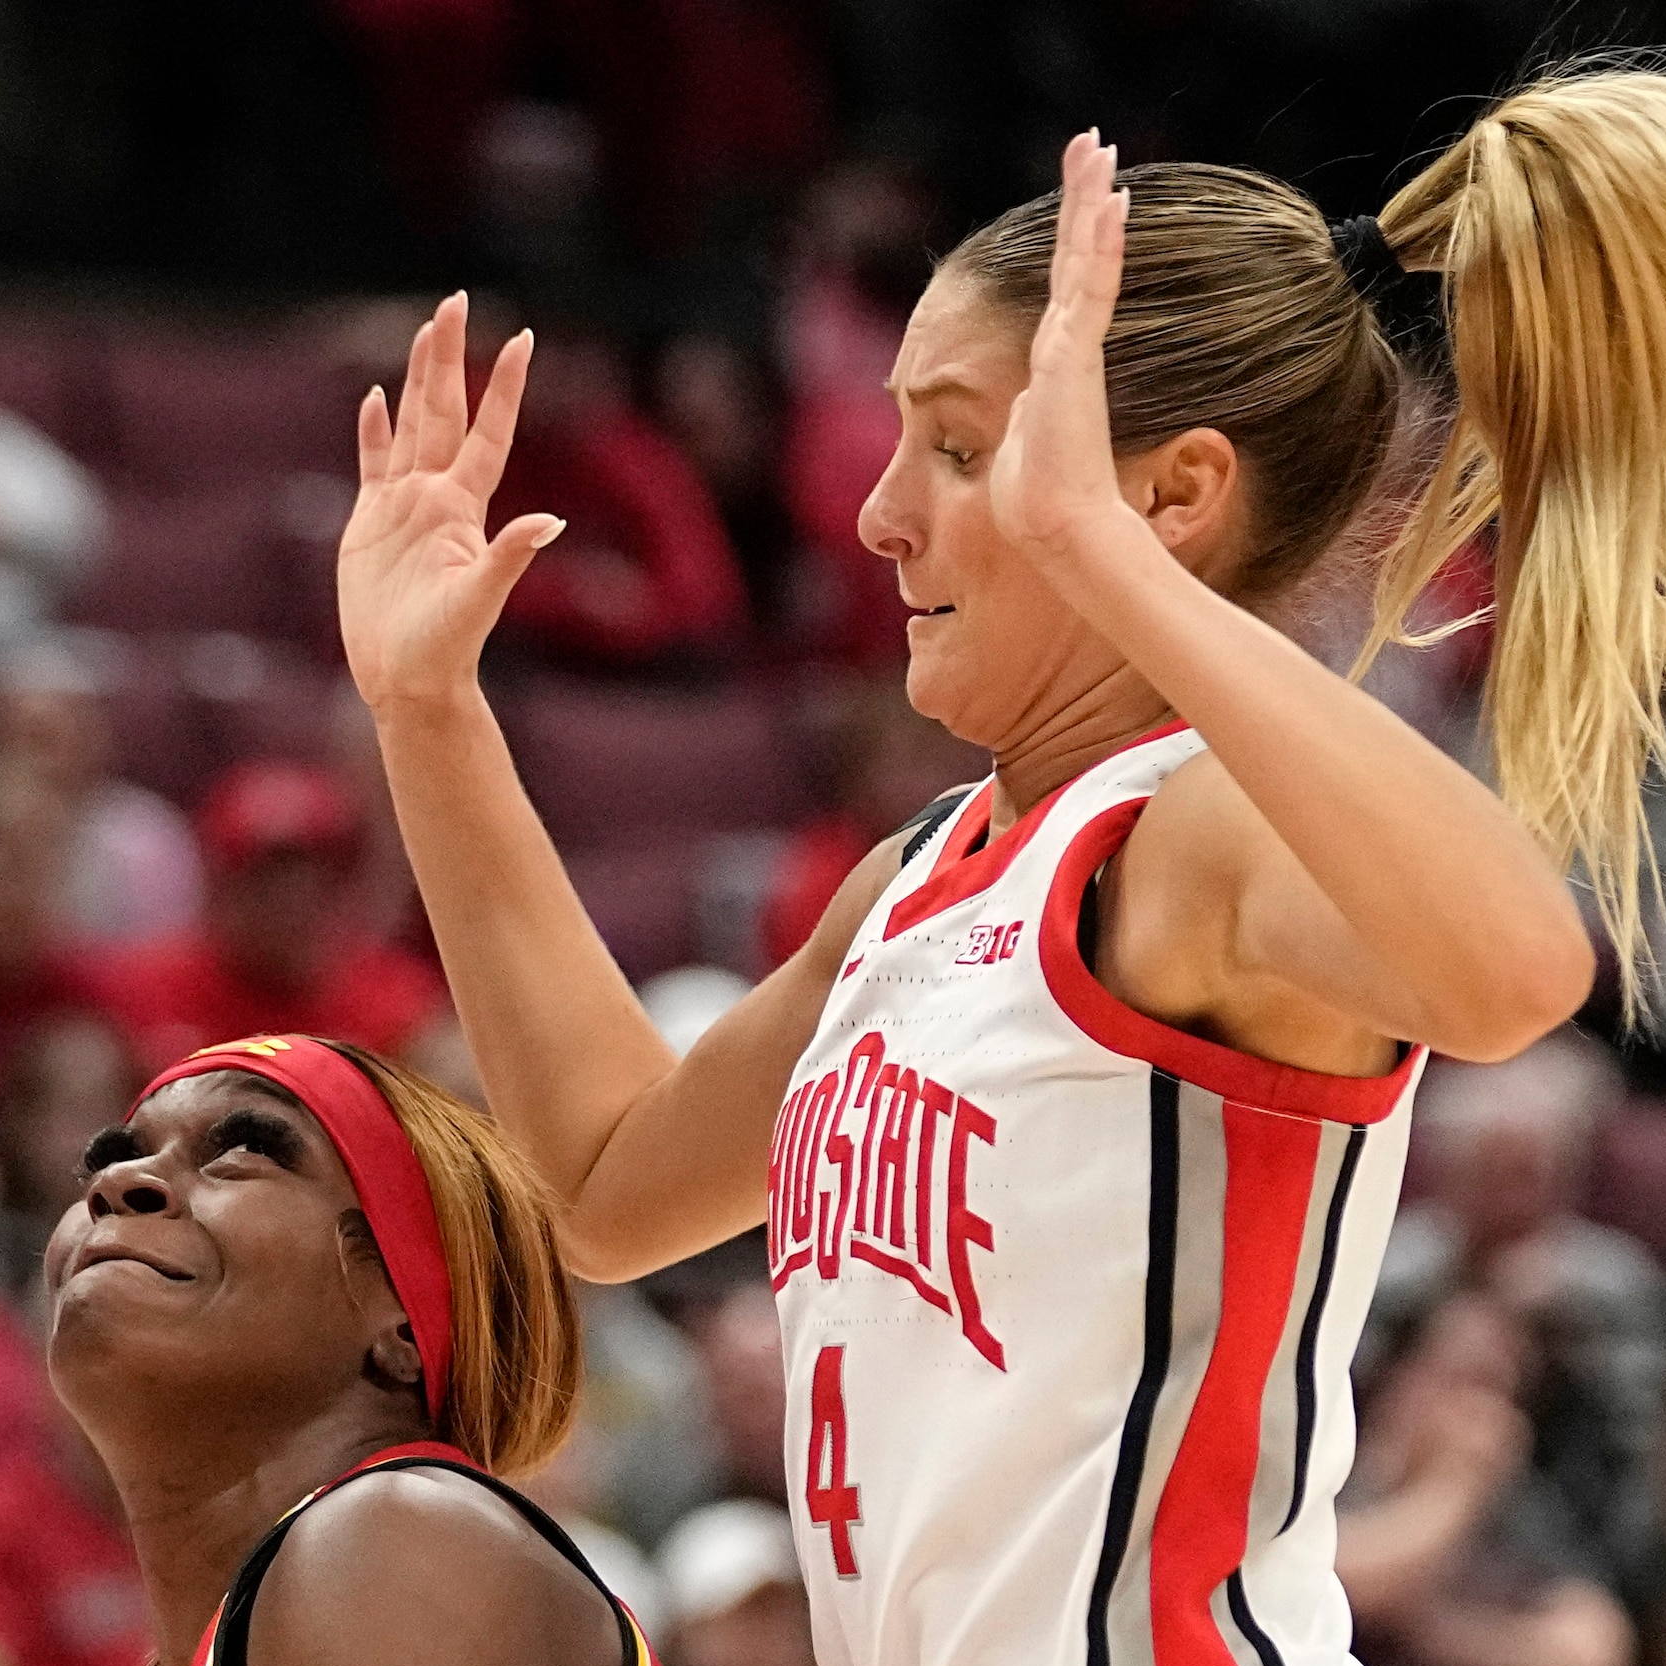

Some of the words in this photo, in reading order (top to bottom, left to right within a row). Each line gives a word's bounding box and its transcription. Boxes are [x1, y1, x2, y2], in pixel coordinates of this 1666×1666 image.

[767, 1069, 840, 1295] HIO
[817, 1031, 1007, 1373] STATE
[806, 1343, 865, 1580] 4
